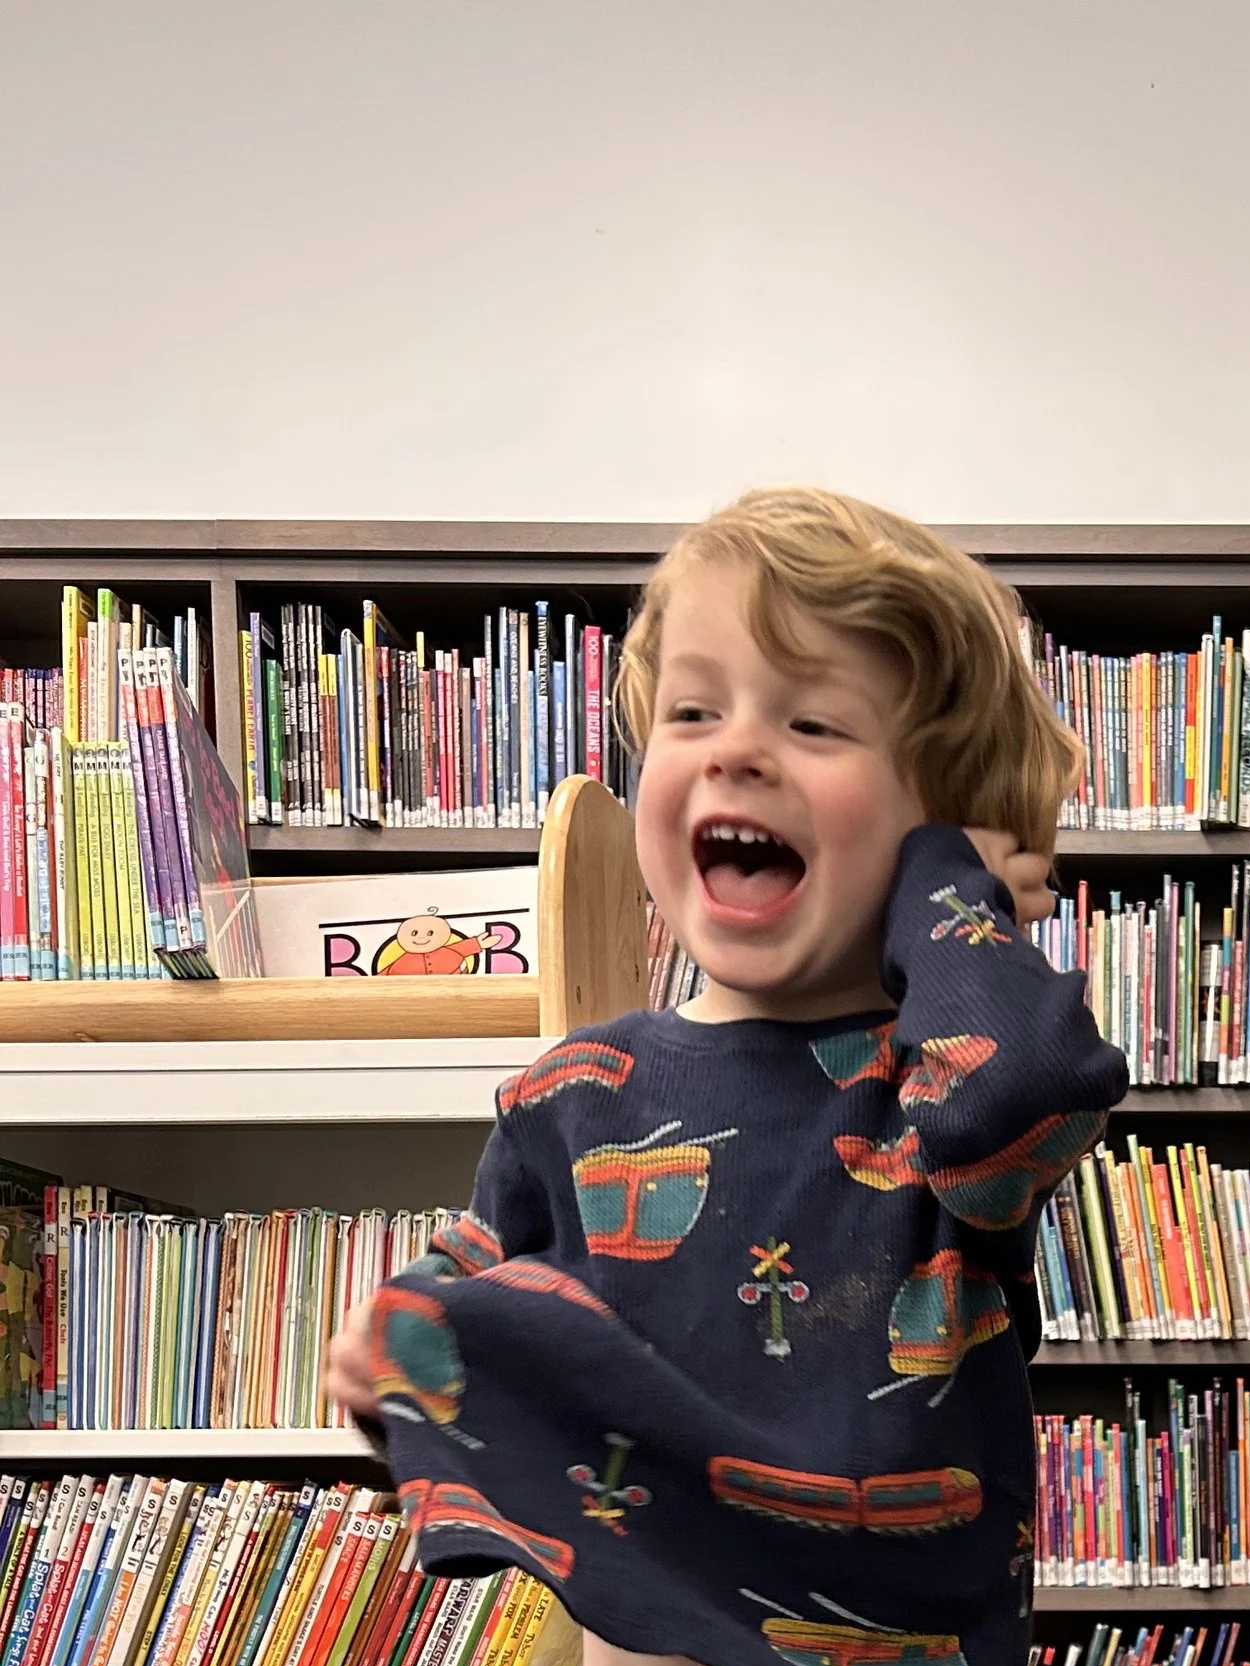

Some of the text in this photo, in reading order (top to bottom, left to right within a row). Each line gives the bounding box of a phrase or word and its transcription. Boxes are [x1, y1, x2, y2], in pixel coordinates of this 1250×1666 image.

[537, 616, 548, 696] EYEWITNESS BOOKS
[246, 688, 256, 751] PLANET EARTH
[586, 634, 601, 753] 100 THE OCEANS
[103, 823, 111, 842] DOG
[339, 1536, 356, 1564] SPACE
[341, 1539, 371, 1602] SALAMANDERS
[367, 1540, 384, 1573] MOTHS
[17, 1563, 47, 1634] Splat Cat
[38, 1559, 67, 1626] Splat Cat
[440, 1597, 465, 1636] WARS
[504, 1602, 515, 1620] FOX
[511, 1602, 533, 1641] PROBLEM
[518, 1598, 549, 1661] LATE Tabor
